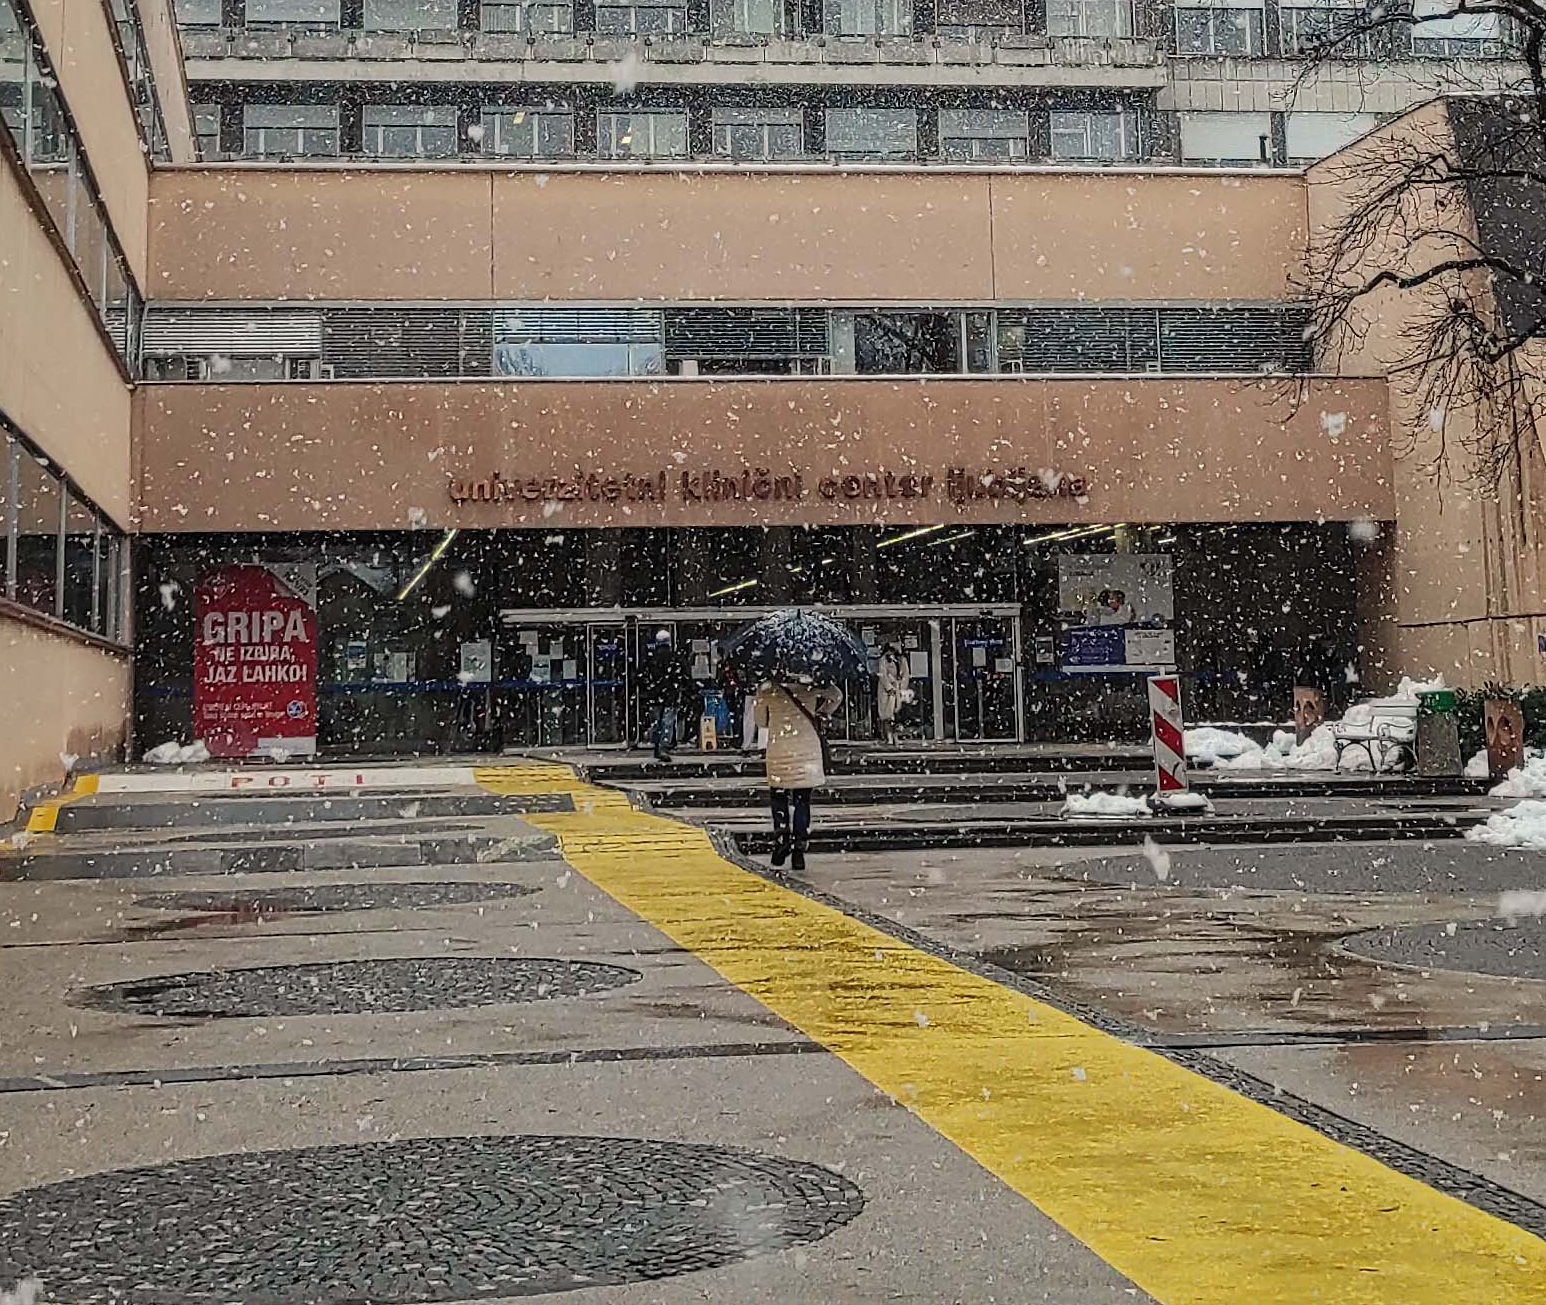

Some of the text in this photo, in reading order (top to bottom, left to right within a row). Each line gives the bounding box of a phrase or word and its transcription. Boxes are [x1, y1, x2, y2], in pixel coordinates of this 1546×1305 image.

[818, 471, 934, 500] center
[203, 611, 307, 643] GRIPA
[214, 645, 235, 662] NE
[204, 664, 308, 683] JAZ LAHKO!
